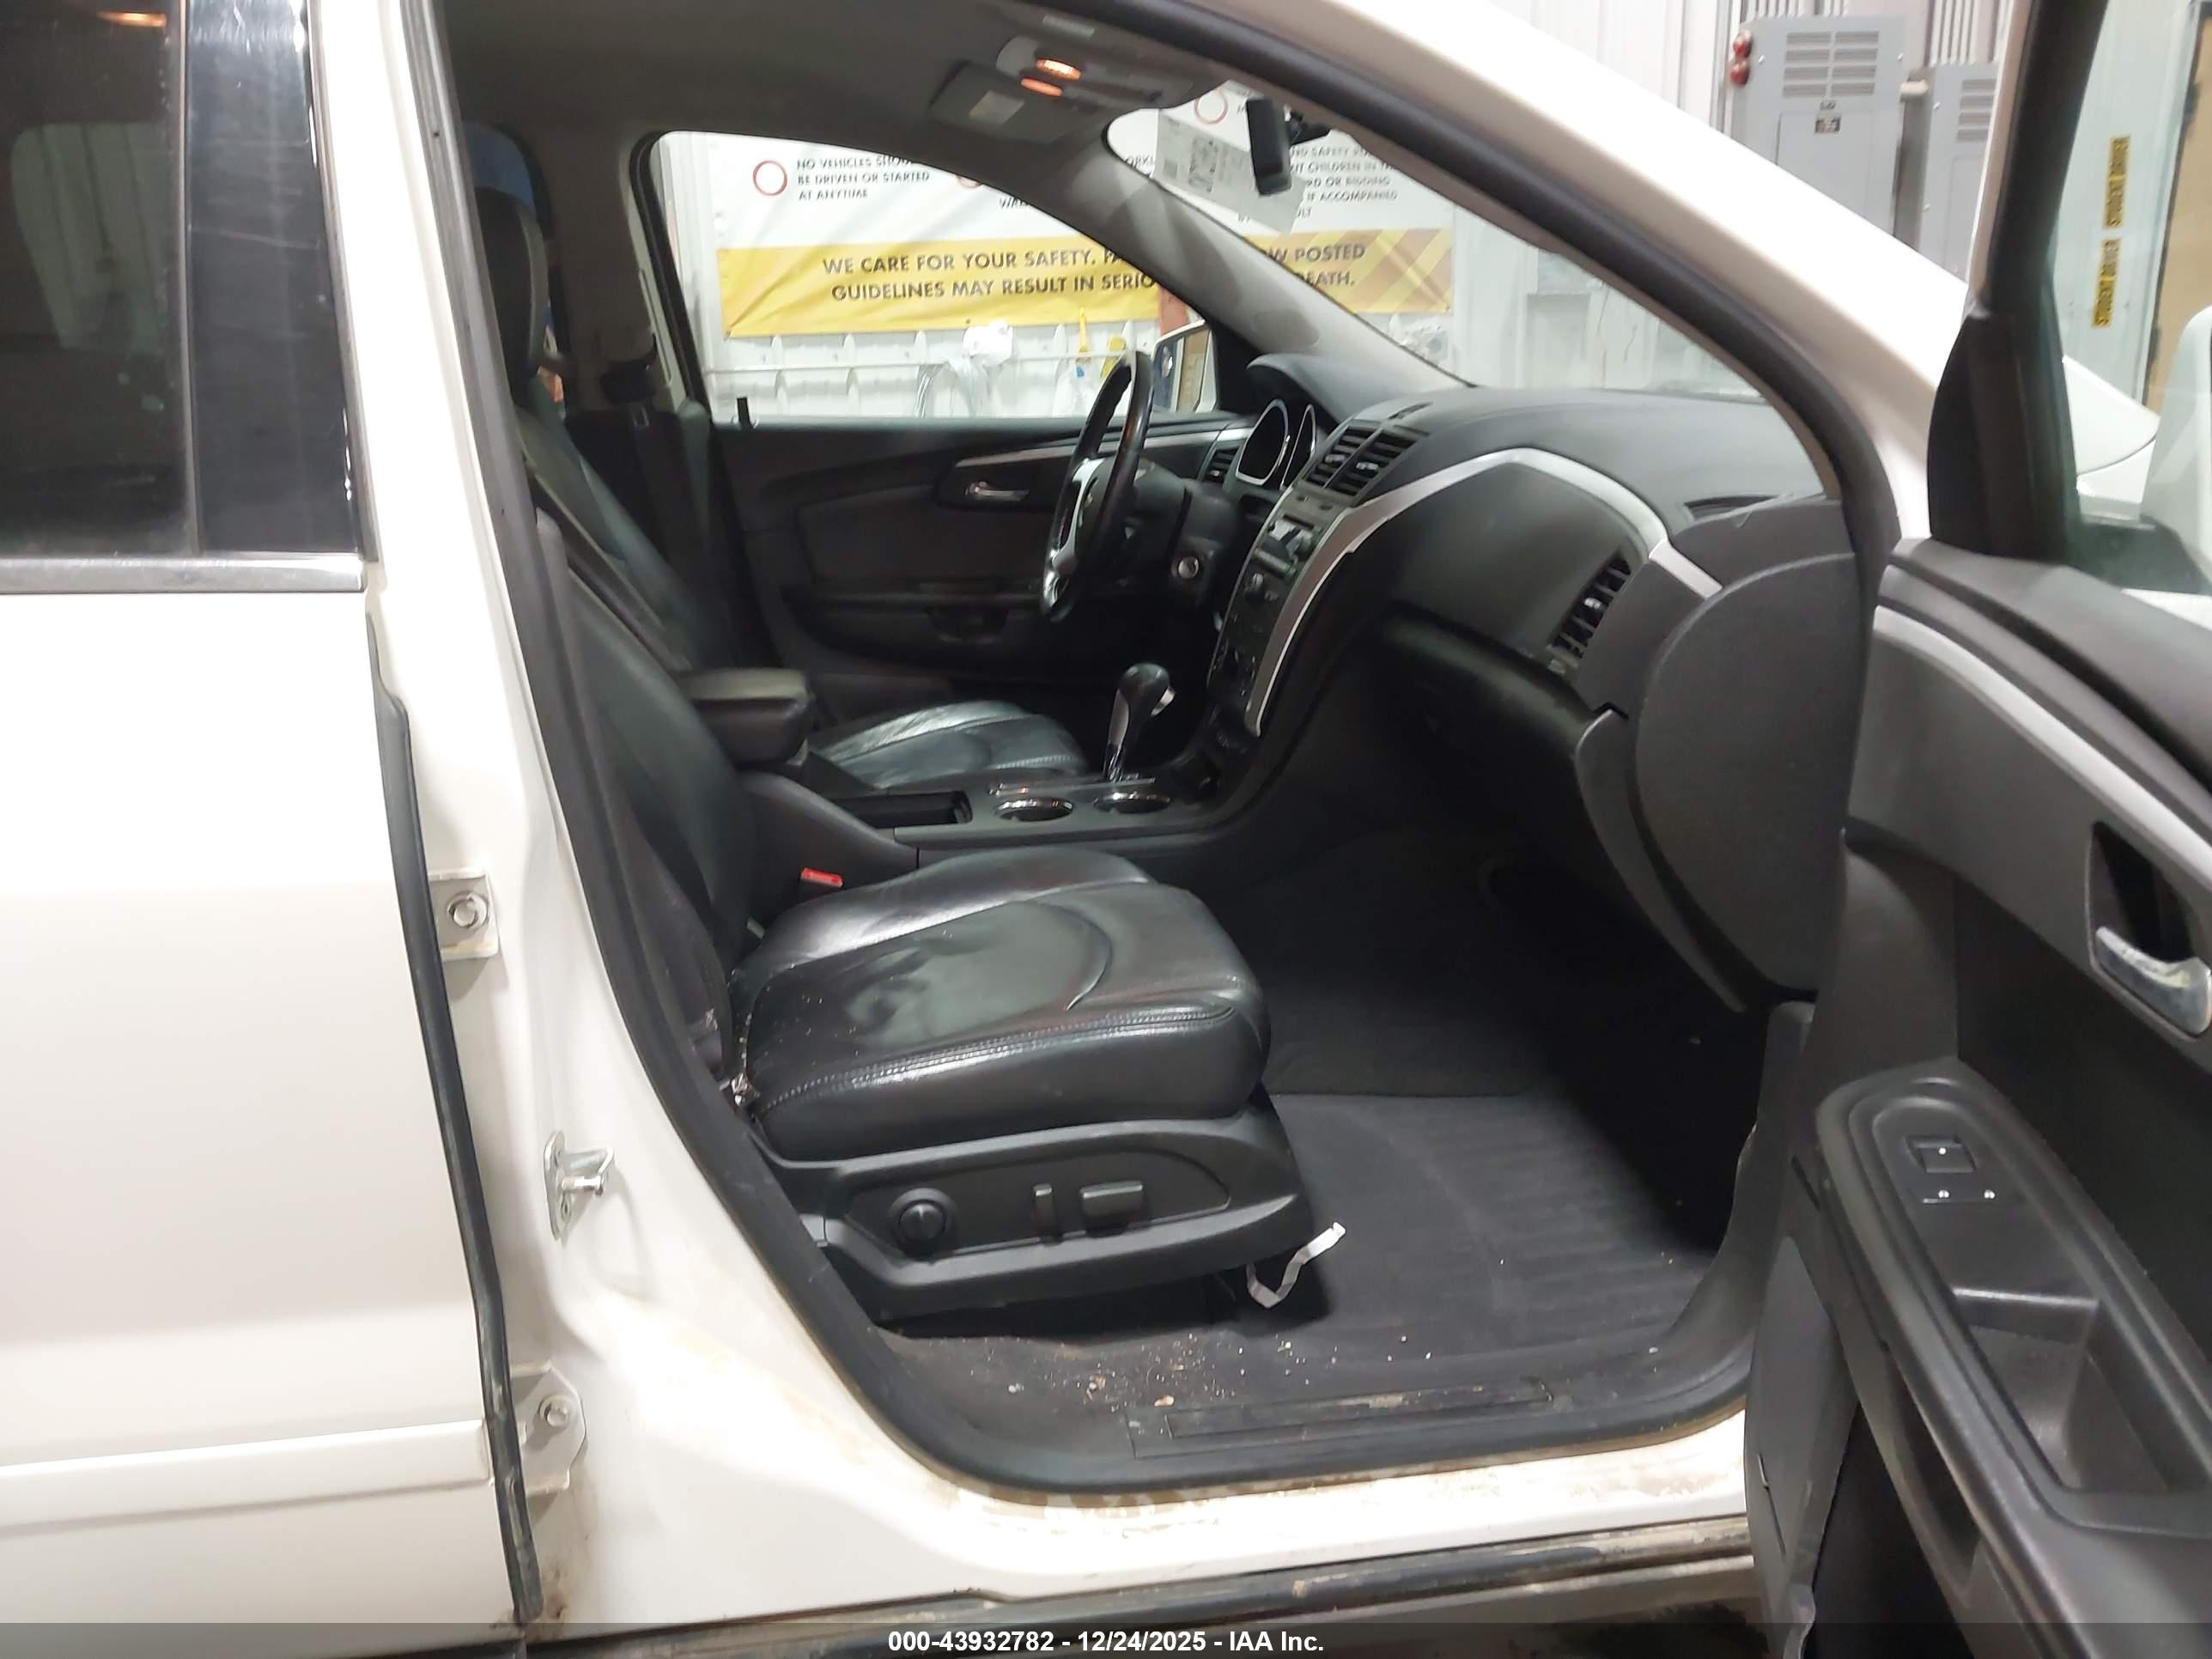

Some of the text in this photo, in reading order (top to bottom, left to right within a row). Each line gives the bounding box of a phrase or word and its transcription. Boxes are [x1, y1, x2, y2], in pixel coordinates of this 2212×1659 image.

[819, 157, 872, 168] VEHICLES
[798, 173, 810, 185] BE
[815, 172, 857, 184] DRIVEN
[883, 171, 930, 182] STARTED
[817, 188, 868, 200] ANYTIME
[823, 258, 854, 274] WE
[860, 256, 909, 273] CARE
[917, 254, 955, 270] FOR
[963, 252, 1017, 269] YOUR
[1024, 248, 1096, 267] SAFETY.
[1294, 243, 1365, 262] POSTED
[831, 281, 945, 301] GUIDELINES
[952, 279, 994, 297] MAY
[1002, 276, 1067, 295] RESULT
[1074, 274, 1095, 290] IN
[1102, 271, 1154, 289] SERIO
